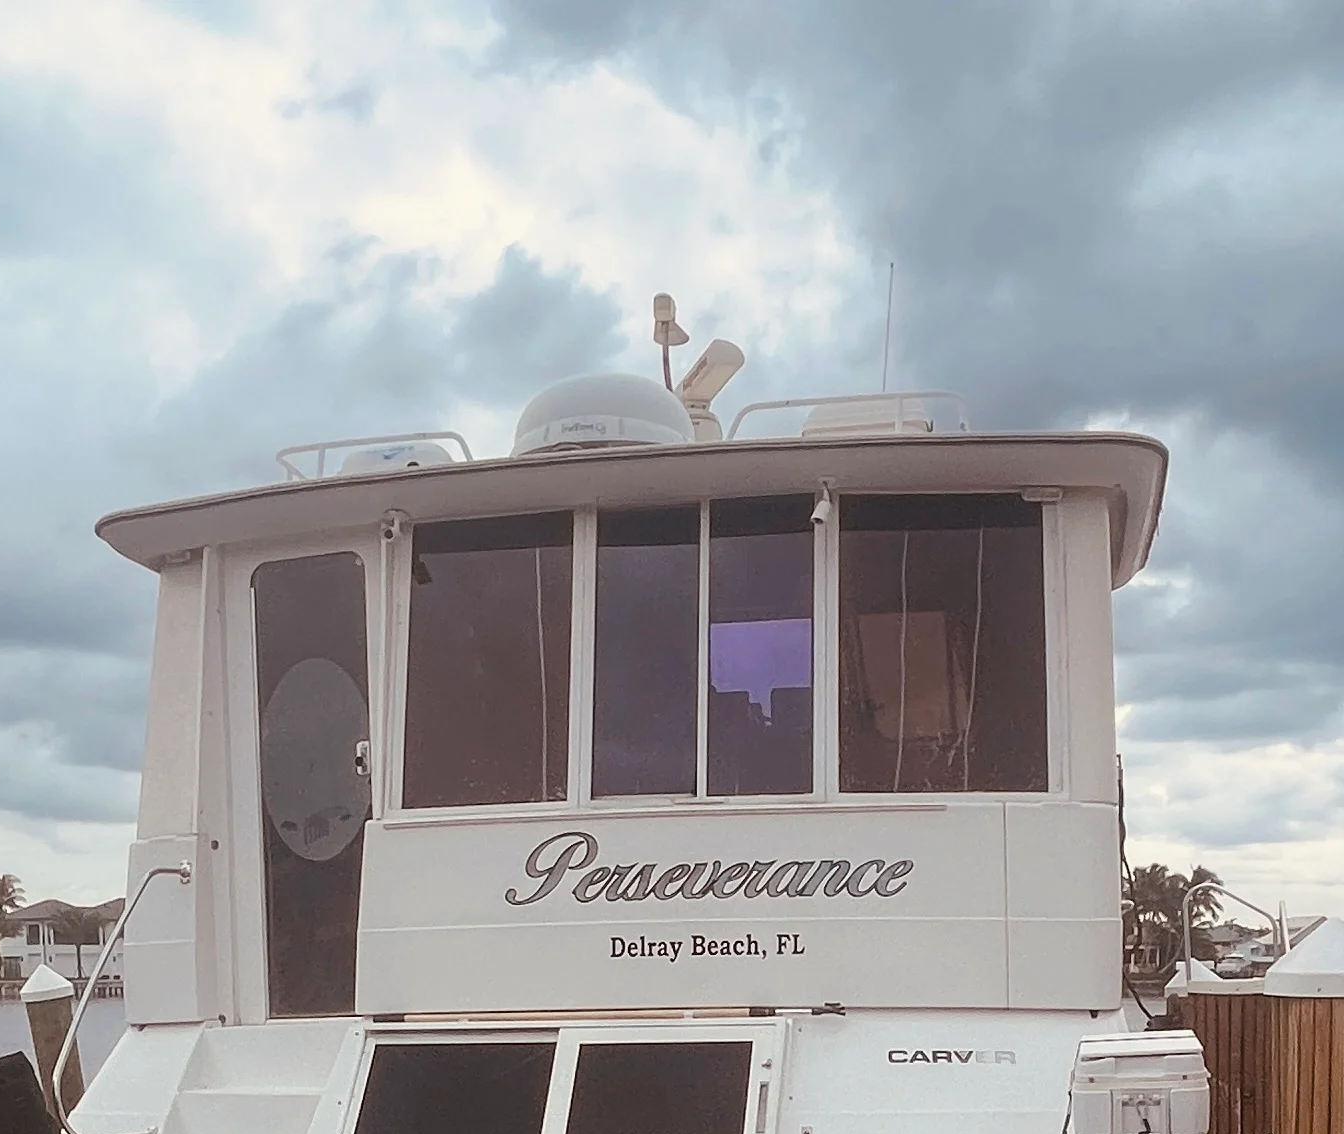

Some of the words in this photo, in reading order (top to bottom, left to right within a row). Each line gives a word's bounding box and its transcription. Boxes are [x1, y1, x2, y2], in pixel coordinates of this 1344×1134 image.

[504, 831, 914, 906] Perseverance
[610, 936, 683, 963] Delray
[691, 934, 768, 960] Beach,
[776, 933, 806, 955] FL
